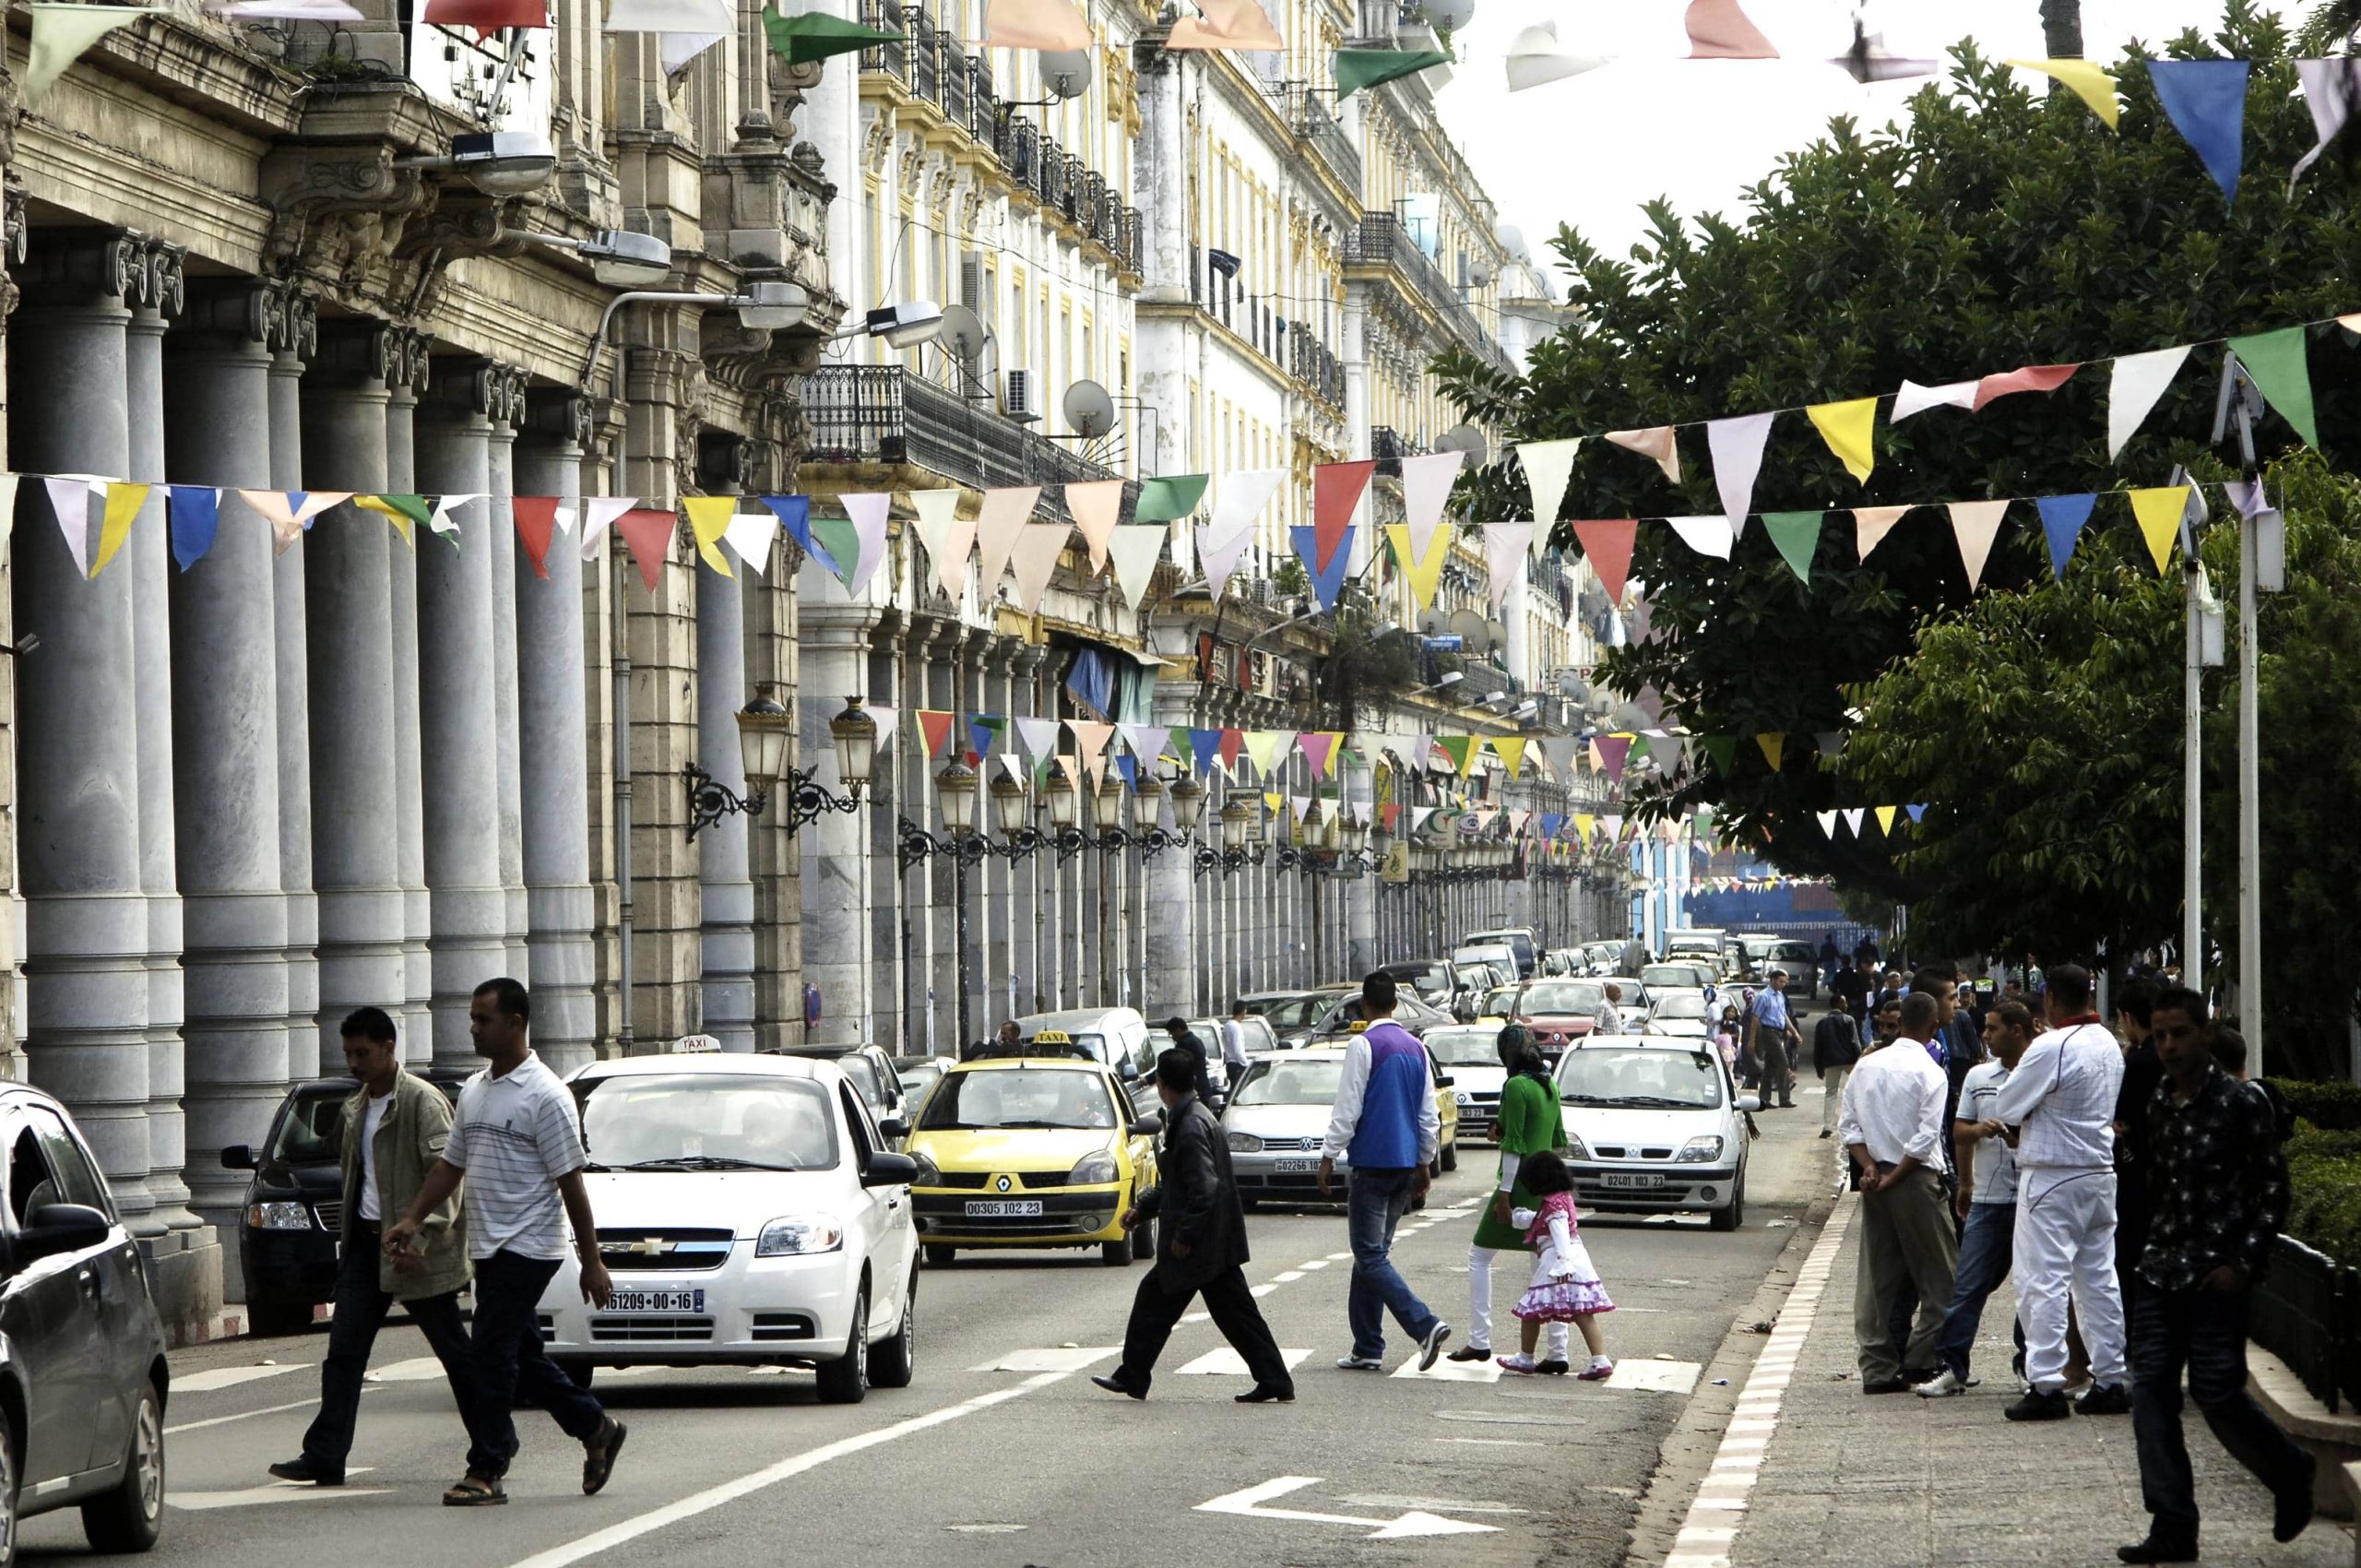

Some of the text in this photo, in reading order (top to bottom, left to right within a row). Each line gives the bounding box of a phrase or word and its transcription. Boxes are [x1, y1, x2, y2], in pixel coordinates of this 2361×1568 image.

[1038, 1033, 1063, 1041] TAXI
[683, 1039, 706, 1049] TAXI
[1608, 1175, 1664, 1187] 02401 103 23
[967, 1202, 1040, 1214] 00305 102 23
